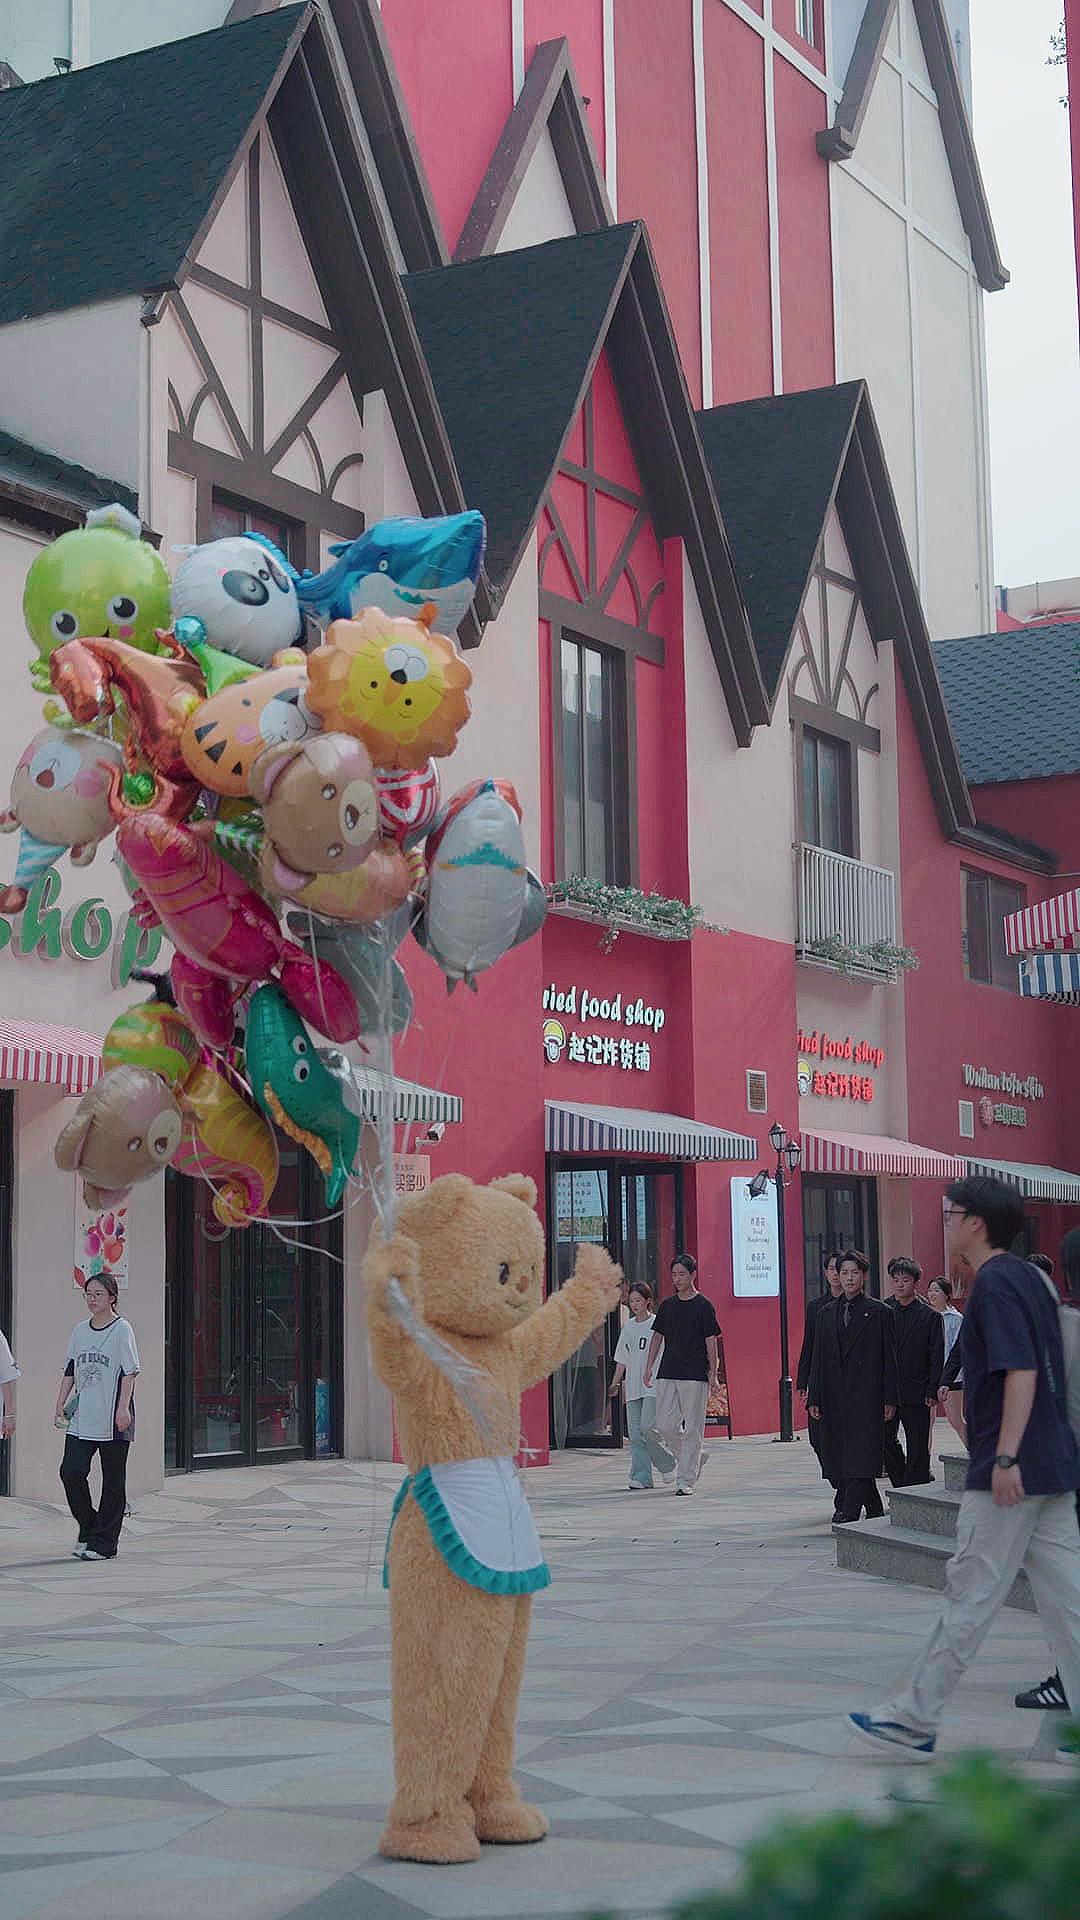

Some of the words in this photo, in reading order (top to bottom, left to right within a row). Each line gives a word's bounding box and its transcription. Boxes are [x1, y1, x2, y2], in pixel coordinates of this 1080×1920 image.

[581, 989, 622, 1023] food
[625, 998, 666, 1033] shop
[567, 1031, 652, 1072] 赵记炸货铺
[821, 1032, 852, 1062] food
[854, 1040, 885, 1069] shop
